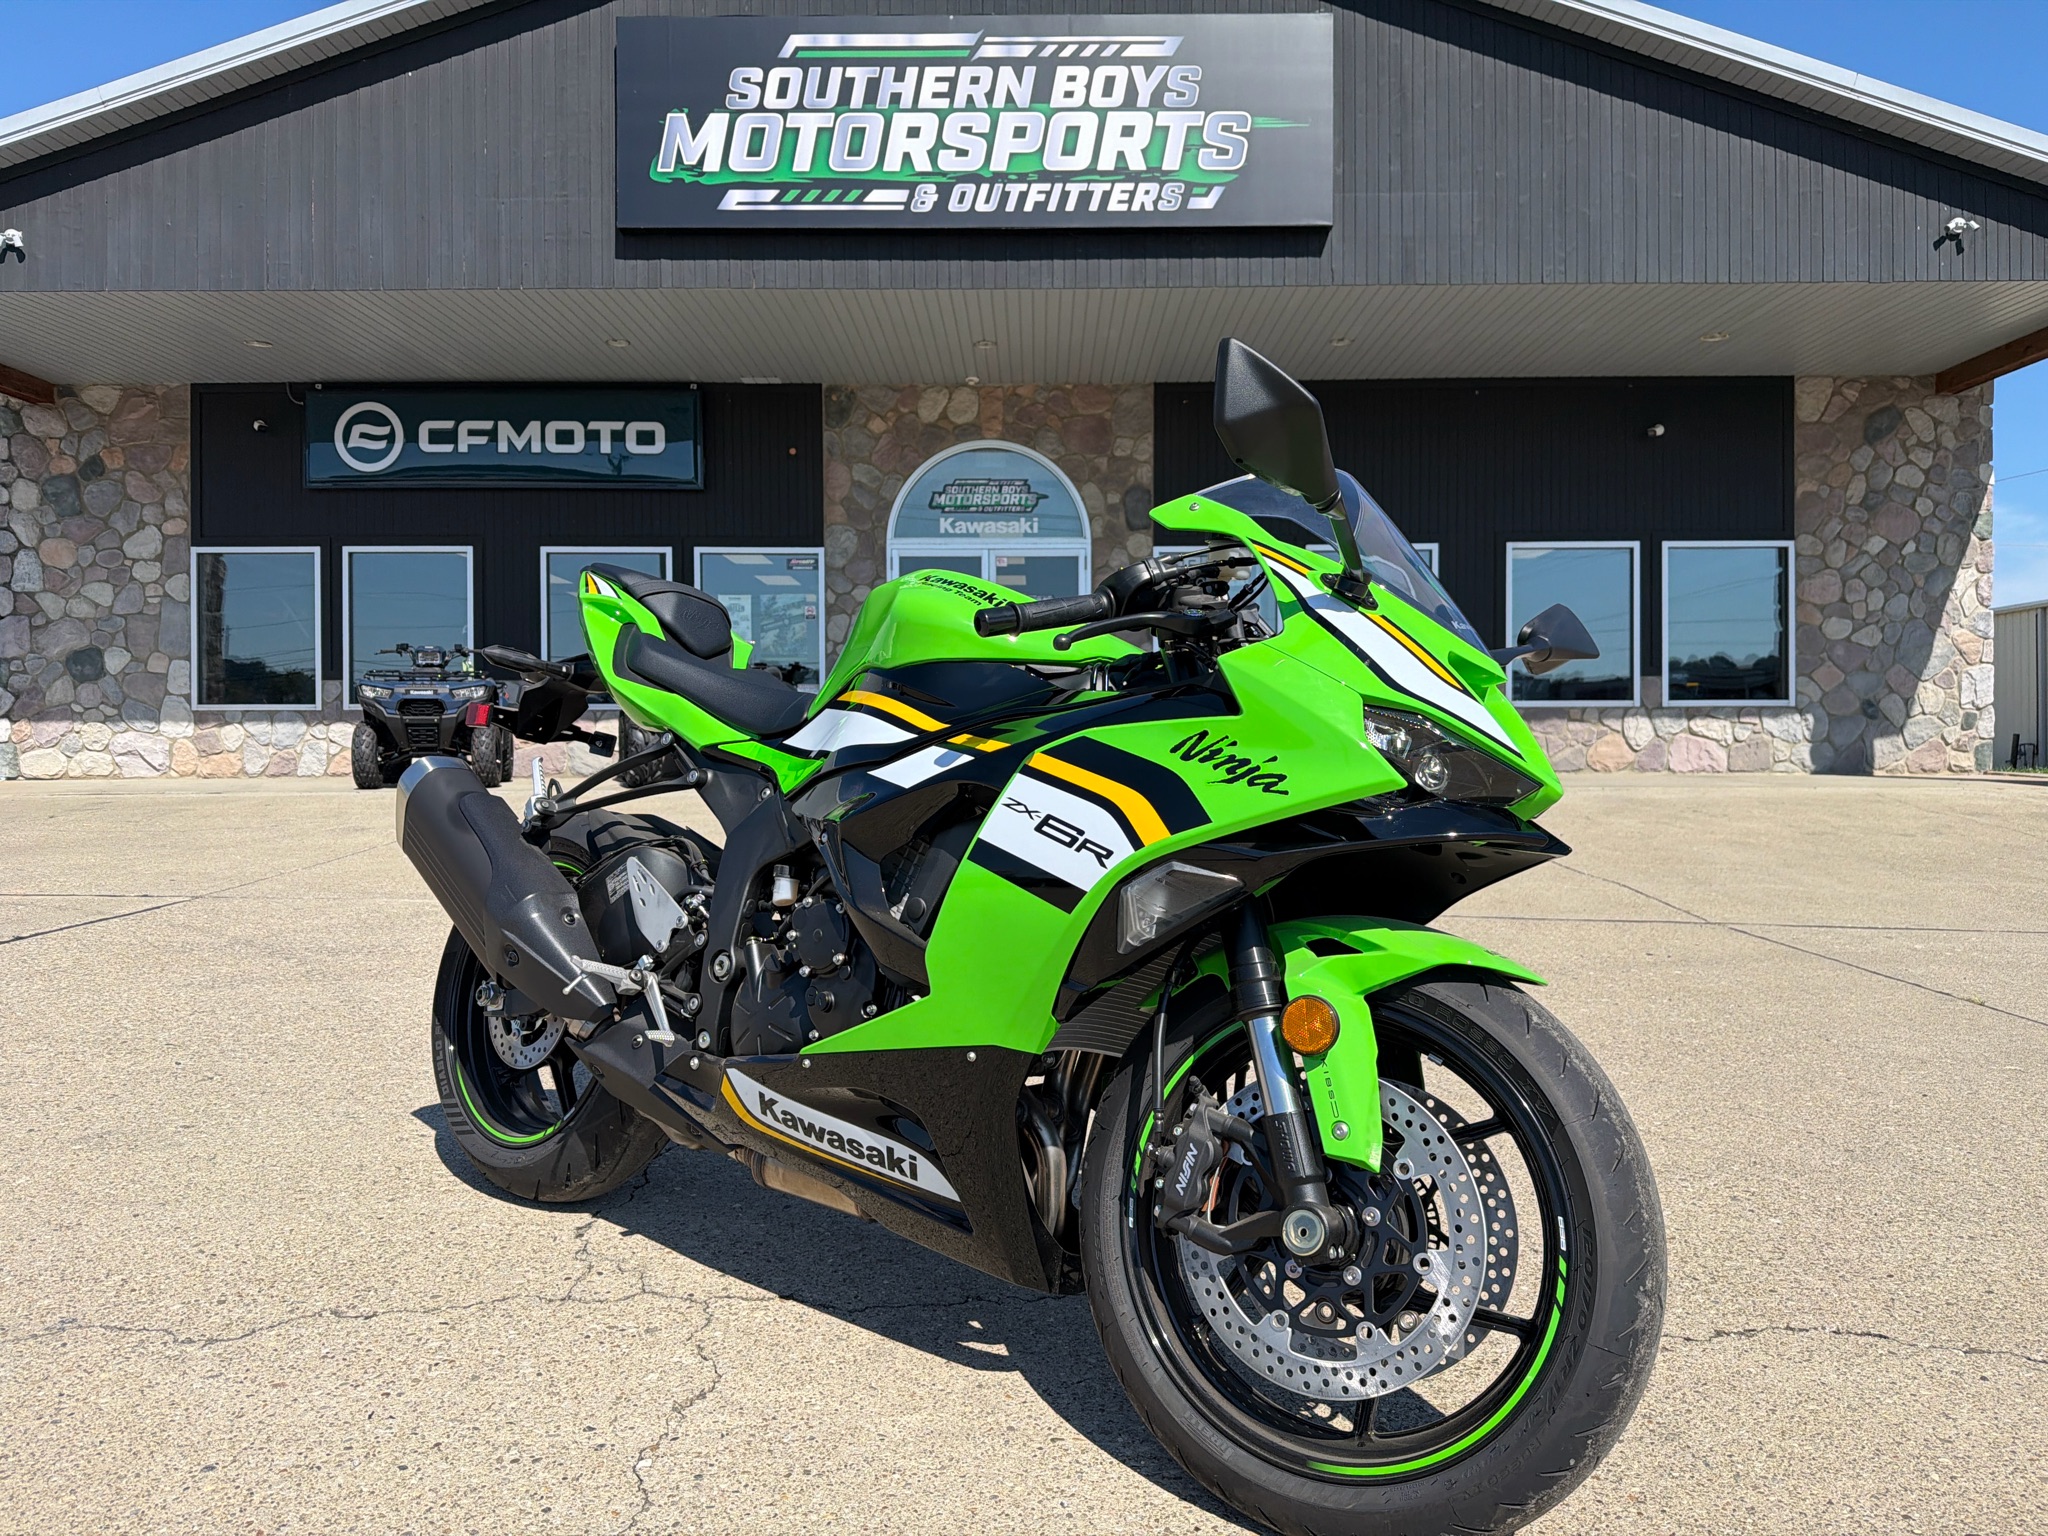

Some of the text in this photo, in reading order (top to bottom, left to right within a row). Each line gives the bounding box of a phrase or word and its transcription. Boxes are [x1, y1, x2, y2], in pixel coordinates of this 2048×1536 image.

[725, 64, 1202, 110] SOUTHERN BOYS
[656, 111, 1252, 173] MOTORSPORTS
[911, 182, 1183, 212] & OUTFITTERS
[417, 420, 667, 455] CFMOTO
[932, 493, 1037, 506] MOTORSPORTS
[945, 484, 1029, 494] SOUTHERN BOYS
[939, 517, 1039, 534] Kawasaki
[919, 575, 1008, 608] Kawasaki
[954, 590, 982, 606] Team
[1169, 729, 1290, 796] Ninja
[1001, 796, 1115, 869] ZX-6R
[758, 1090, 919, 1182] Kawasaki
